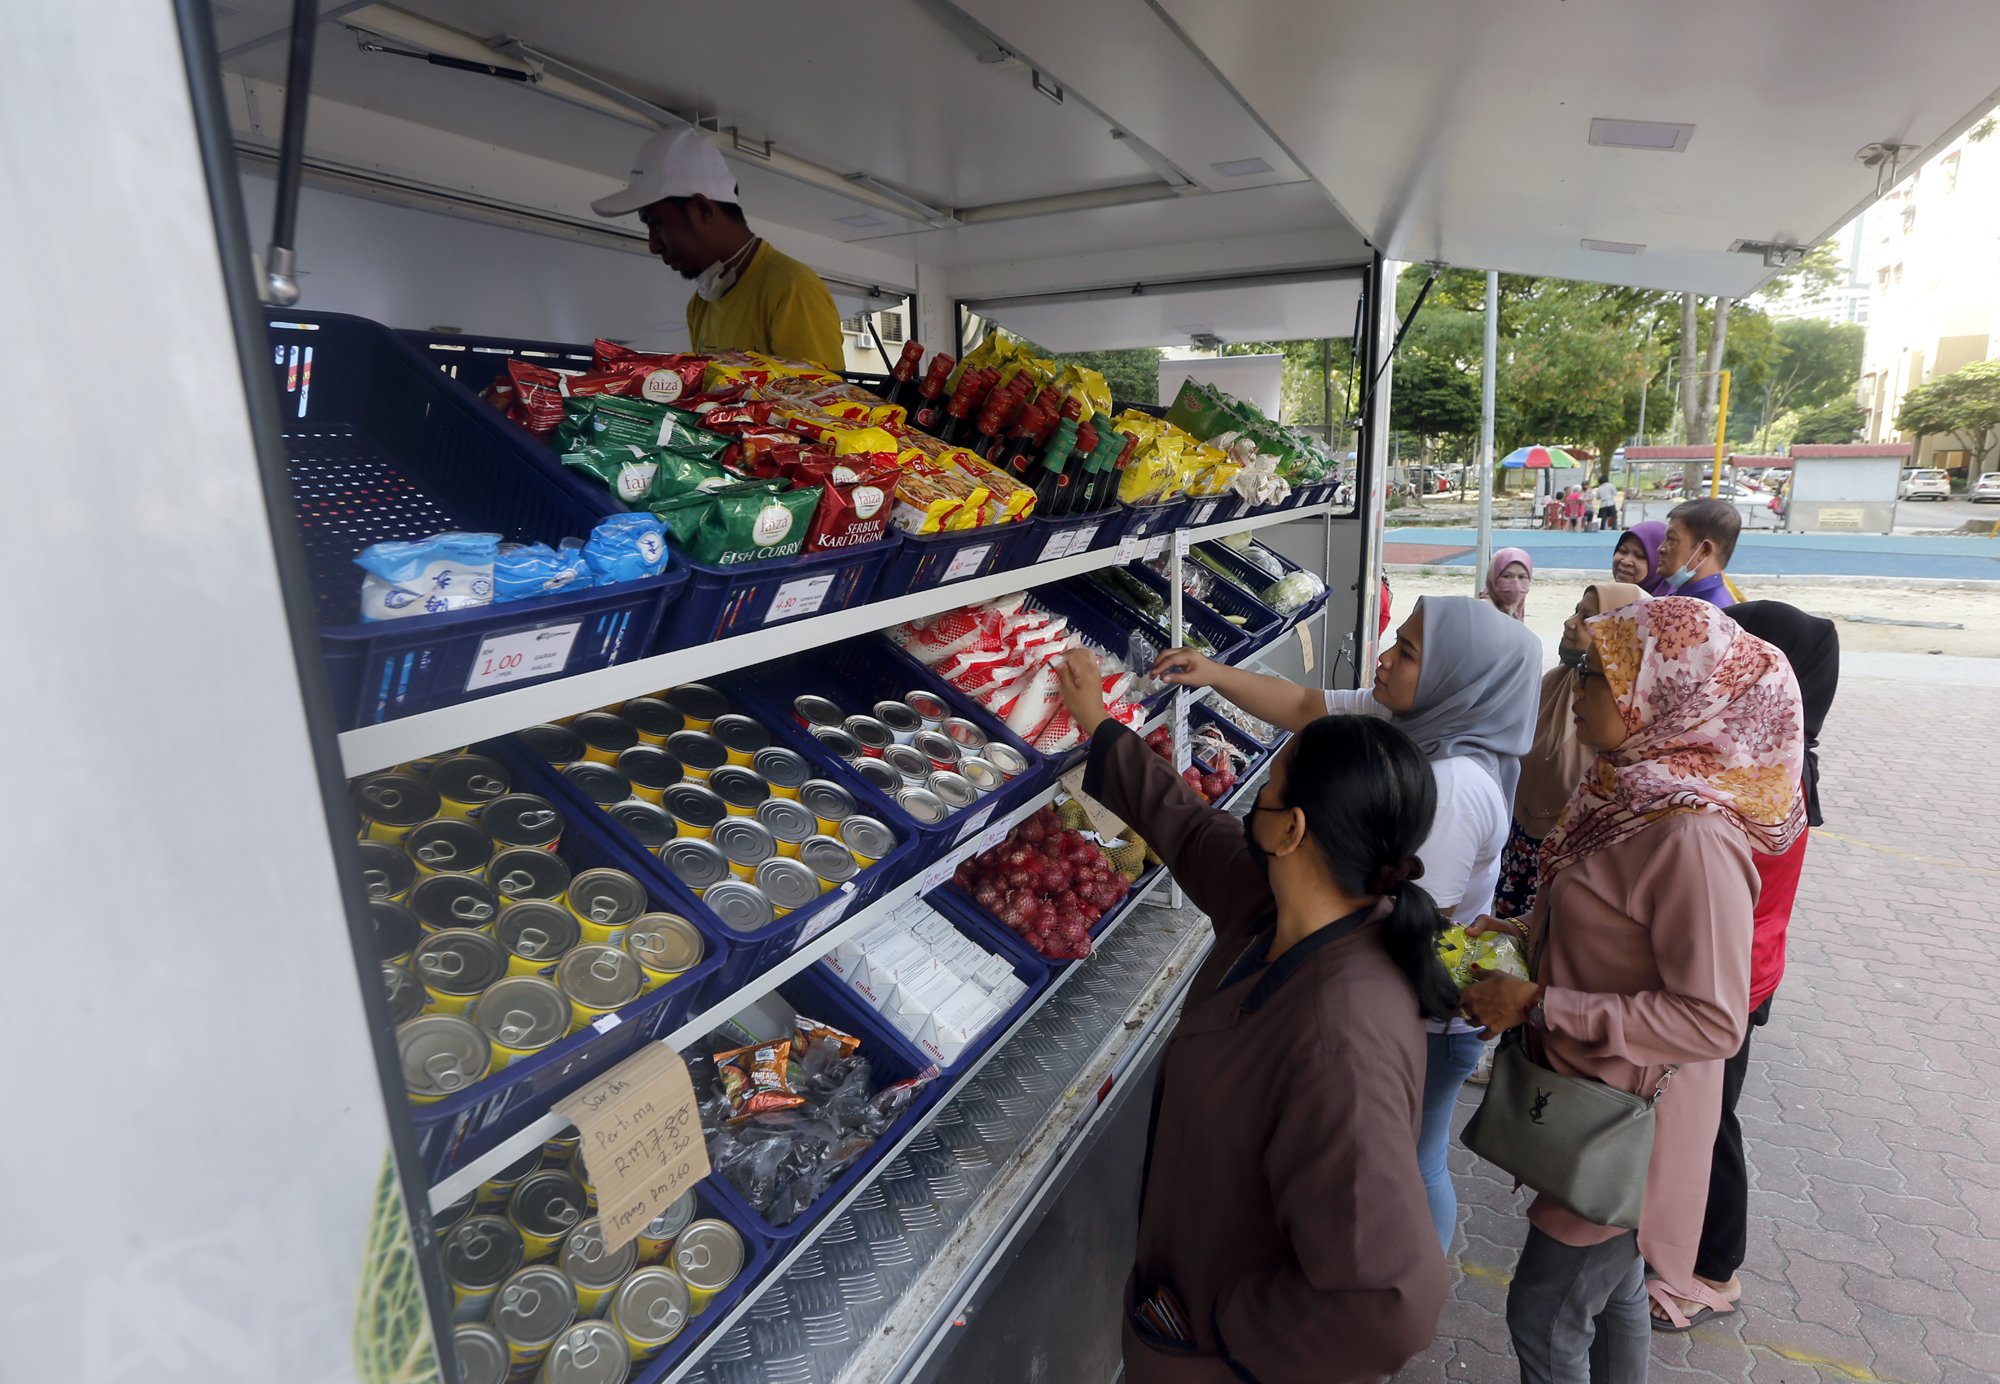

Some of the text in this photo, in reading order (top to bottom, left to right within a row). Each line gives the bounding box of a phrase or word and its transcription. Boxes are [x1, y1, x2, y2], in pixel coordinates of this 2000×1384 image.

[648, 377, 679, 391] faiza
[858, 491, 881, 506] faiza
[760, 516, 788, 533] faiza
[845, 519, 882, 536] SERBUK
[817, 532, 848, 548] KARI
[718, 539, 803, 565] FISH CURRY
[775, 597, 797, 612] 4.80
[481, 652, 523, 676] 1.00
[533, 651, 558, 661] GARAM
[530, 662, 553, 671] HALUS
[855, 980, 877, 1002] emma
[922, 1039, 945, 1061] emma
